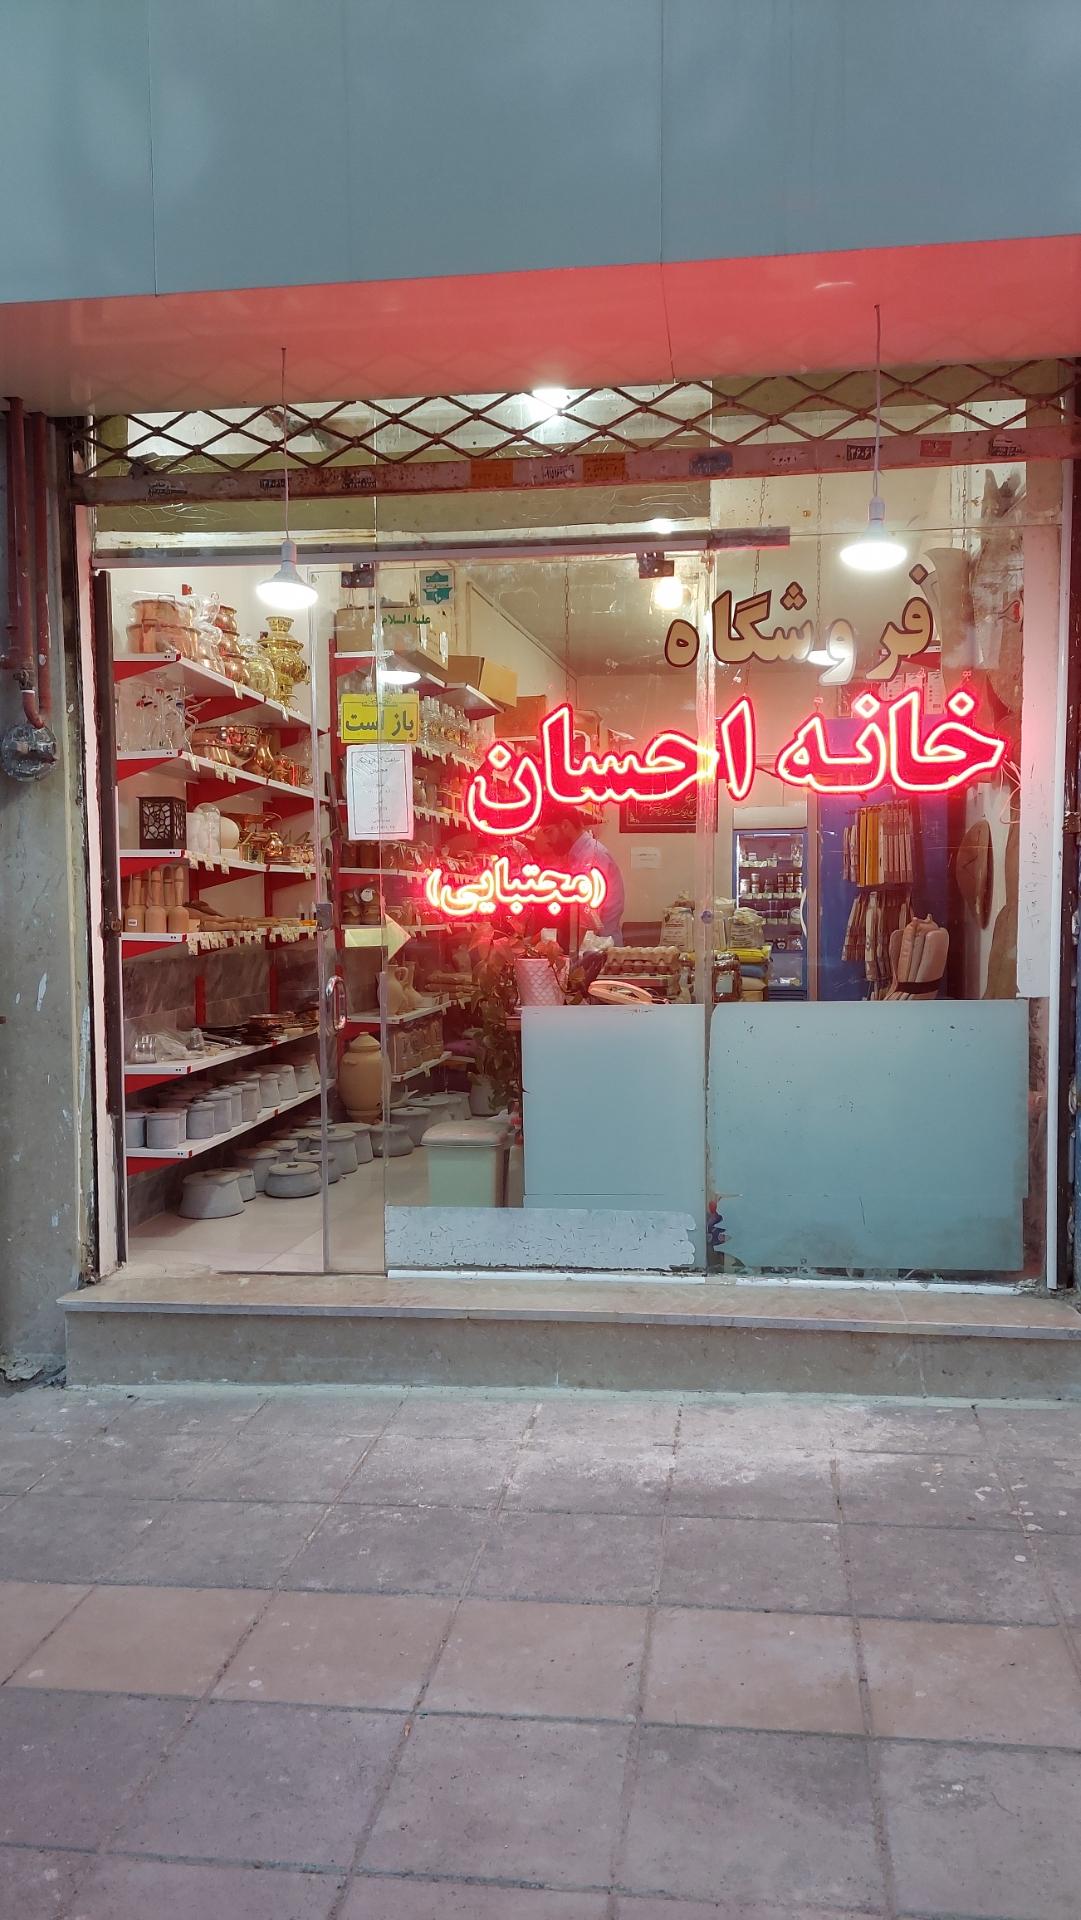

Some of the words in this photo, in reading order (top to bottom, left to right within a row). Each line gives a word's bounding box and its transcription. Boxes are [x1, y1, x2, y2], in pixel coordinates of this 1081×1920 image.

[381, 613, 411, 627] السلام
[664, 563, 935, 687] فروشگاه
[345, 709, 385, 732] است
[391, 710, 415, 738] باز
[776, 689, 1008, 796] خانه
[465, 695, 757, 836] احسان
